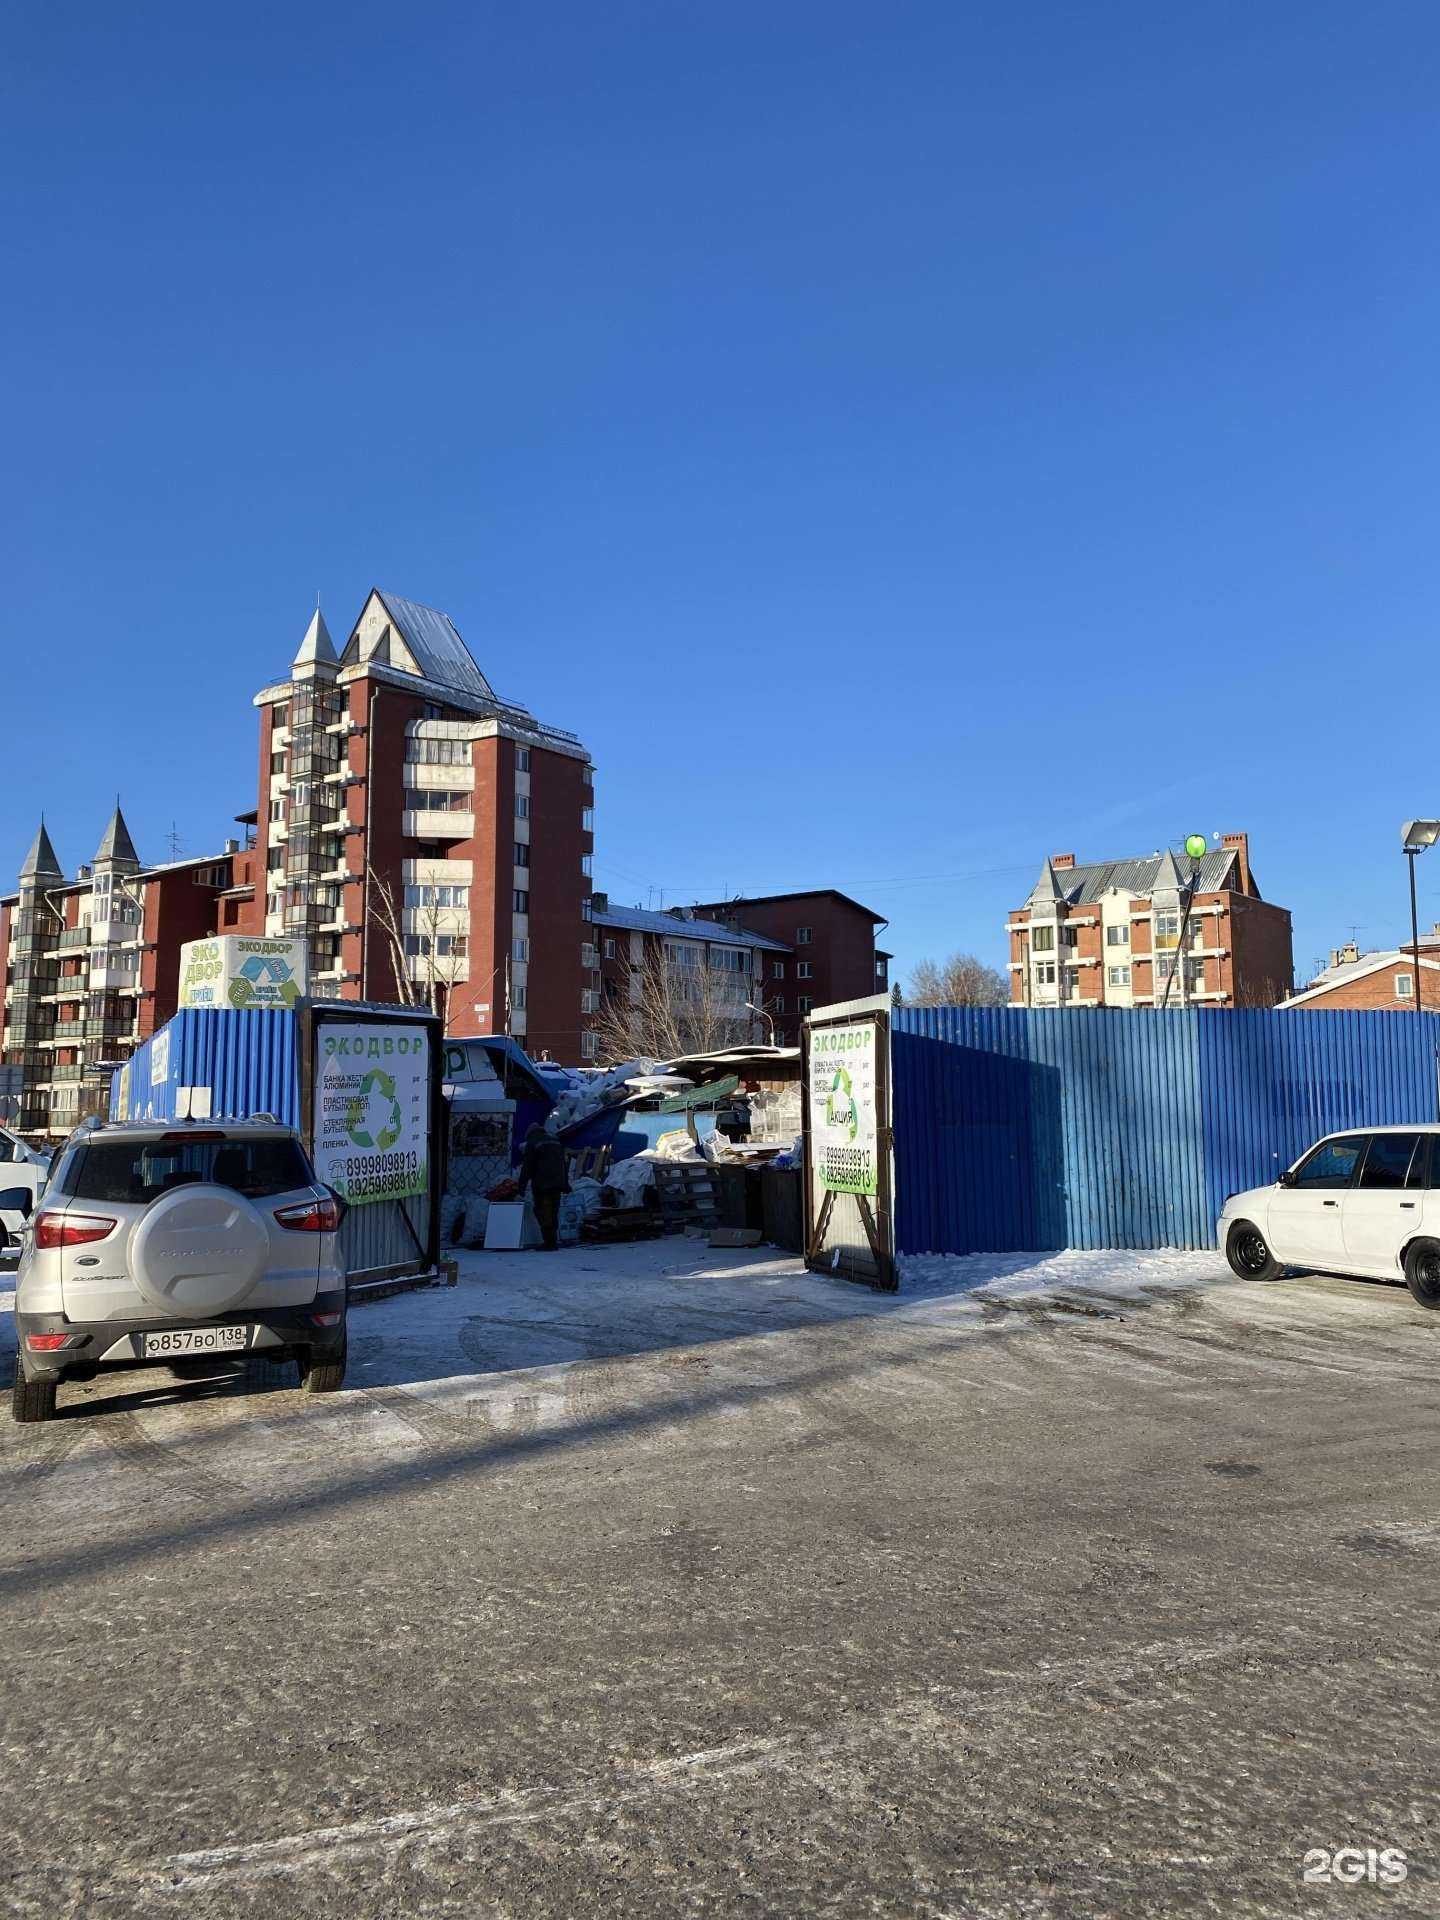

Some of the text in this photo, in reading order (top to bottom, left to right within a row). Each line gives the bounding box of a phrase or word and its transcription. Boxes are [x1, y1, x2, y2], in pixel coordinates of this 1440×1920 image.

[191, 943, 219, 962] ЭКО
[238, 941, 292, 954] ЭКОДВОР
[184, 961, 223, 985] ДВОР
[324, 1037, 423, 1058] ЭКОДВОР
[814, 1031, 871, 1053] ЭКОДВОР
[346, 1150, 417, 1177] 89998098913
[347, 1171, 417, 1197] 89259898913
[218, 1328, 242, 1340] 138
